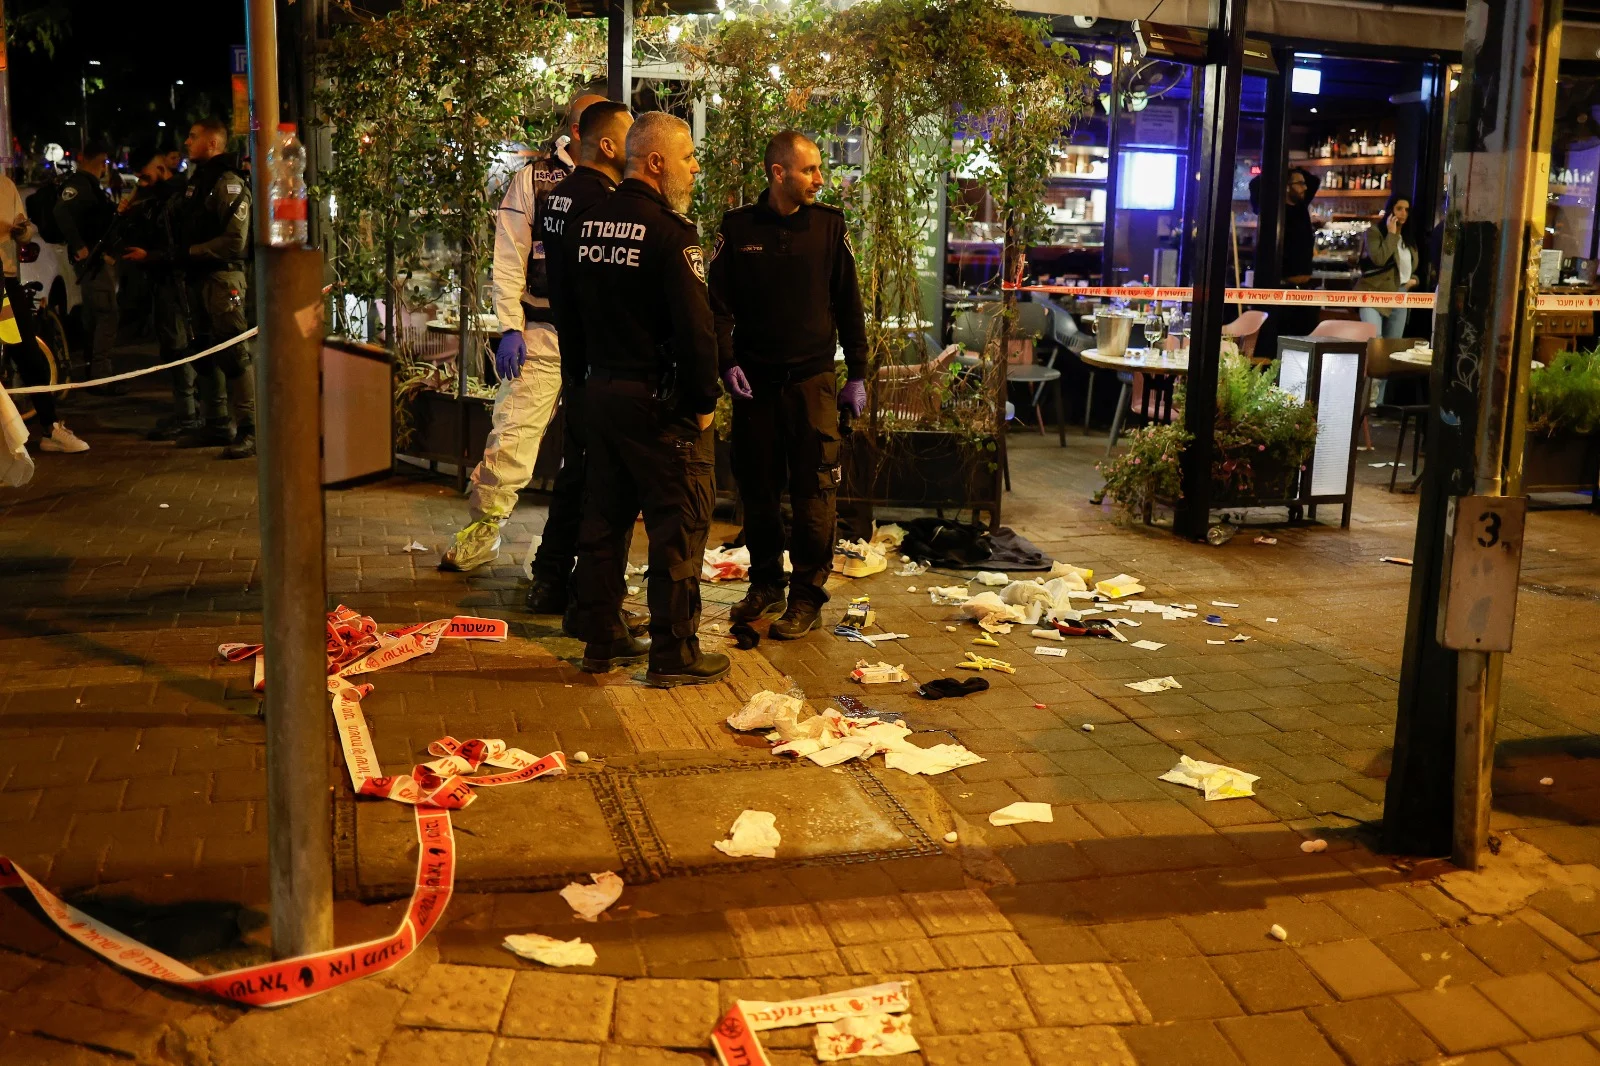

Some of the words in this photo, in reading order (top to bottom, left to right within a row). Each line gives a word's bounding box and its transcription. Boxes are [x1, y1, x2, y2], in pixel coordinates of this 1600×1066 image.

[580, 220, 647, 241] משטרה
[578, 245, 641, 267] POLICE
[1225, 292, 1233, 300] אי
[1247, 292, 1271, 300] ישראל
[1285, 293, 1314, 301] משטרת
[1326, 294, 1346, 303] מעבר
[1346, 295, 1358, 303] אין
[1370, 295, 1393, 304] ישראל
[1406, 296, 1433, 304] משטרת
[1556, 299, 1574, 307] מעבר
[1575, 299, 1585, 307] אין
[1476, 511, 1502, 548] 3
[450, 623, 496, 633] משטרת
[380, 643, 414, 664] ישראל
[447, 782, 472, 803] עבר
[329, 952, 357, 979] אין
[363, 938, 406, 968] מעבר
[747, 1005, 803, 1022] מעבר
